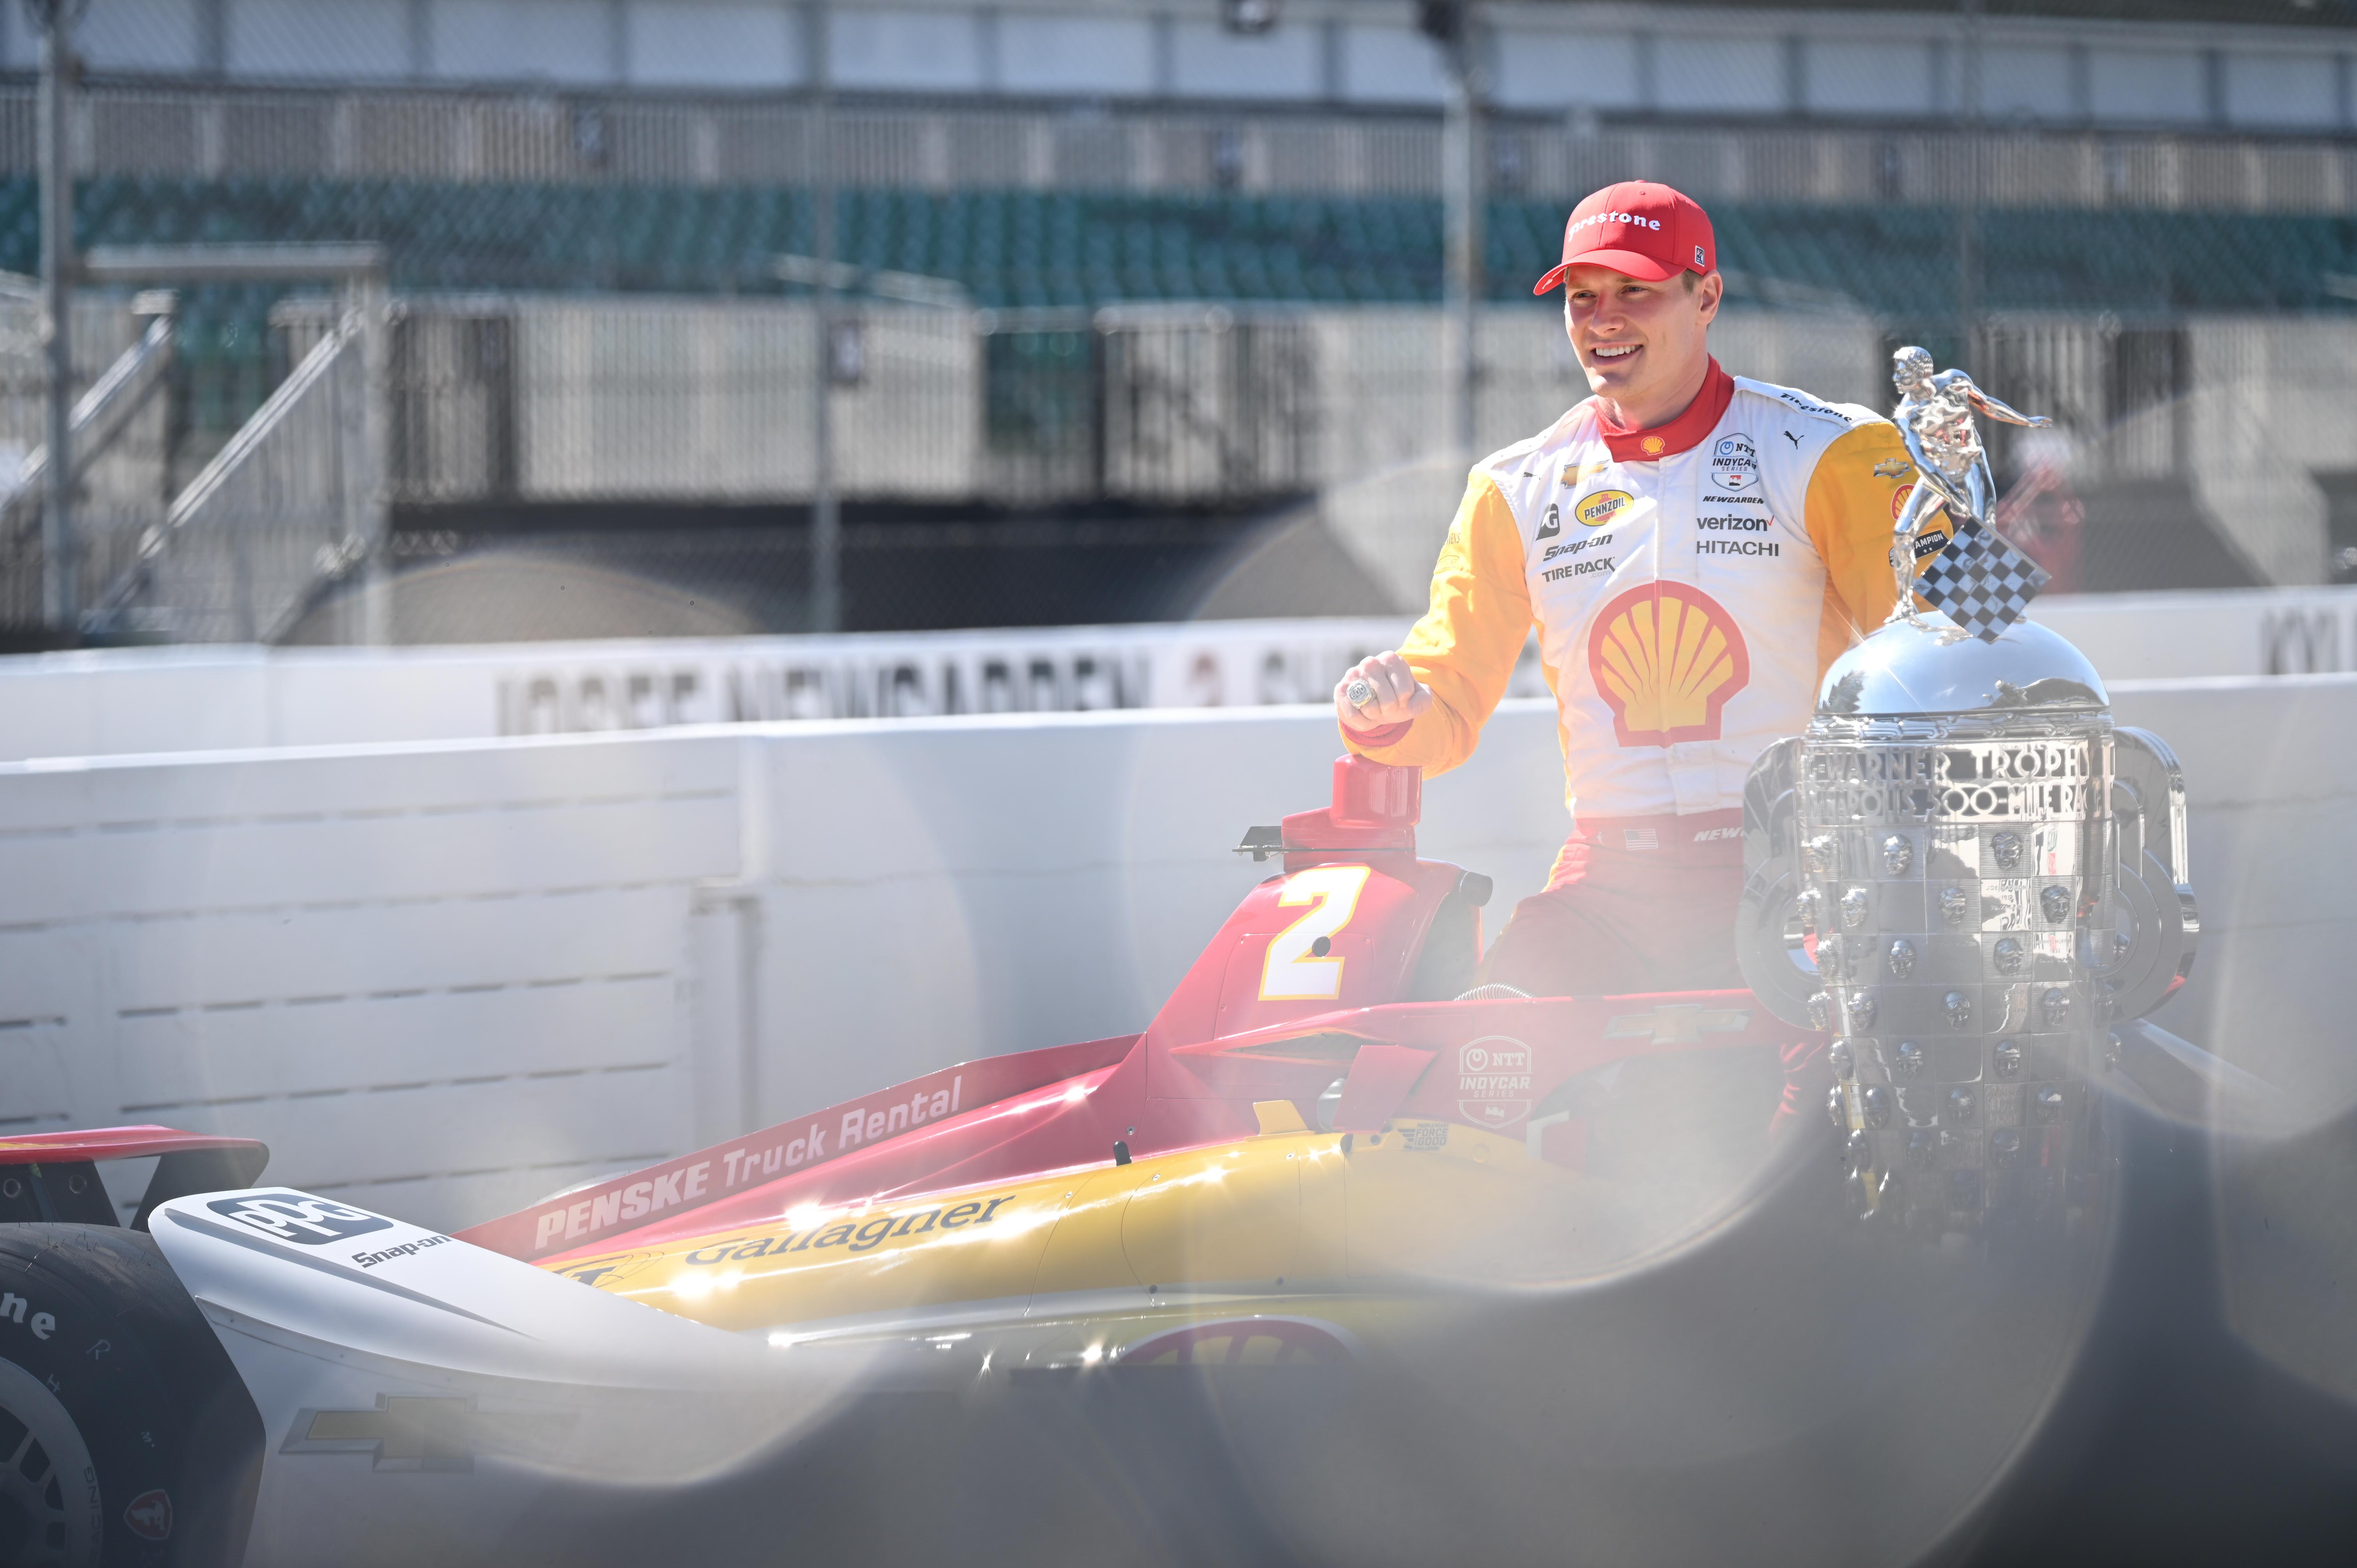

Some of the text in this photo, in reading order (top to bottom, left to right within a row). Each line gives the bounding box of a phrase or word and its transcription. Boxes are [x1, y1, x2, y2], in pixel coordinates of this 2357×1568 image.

[1780, 393, 1853, 422] Firestone
[1736, 443, 1755, 457] NTT
[1584, 497, 1626, 520] PENNZOIL
[1696, 514, 1768, 531] verizon
[1543, 534, 1613, 562] Snap-on
[1696, 540, 1779, 556] HITACHI
[1914, 533, 1944, 549] AMPION
[1542, 557, 1615, 582] TIRE RACK
[1590, 570, 1611, 579] .com
[1694, 826, 1744, 842] NEW
[1258, 865, 1371, 1001] 2
[1492, 1052, 1525, 1066] NTT
[1459, 1076, 1530, 1090] INDYCAR
[1416, 1128, 1448, 1137] FORCE
[1417, 1137, 1447, 1146] GOOD
[535, 1075, 962, 1251] PENSKE Truck Rental
[228, 1199, 372, 1238] PPG
[352, 1234, 452, 1268] Snap-on
